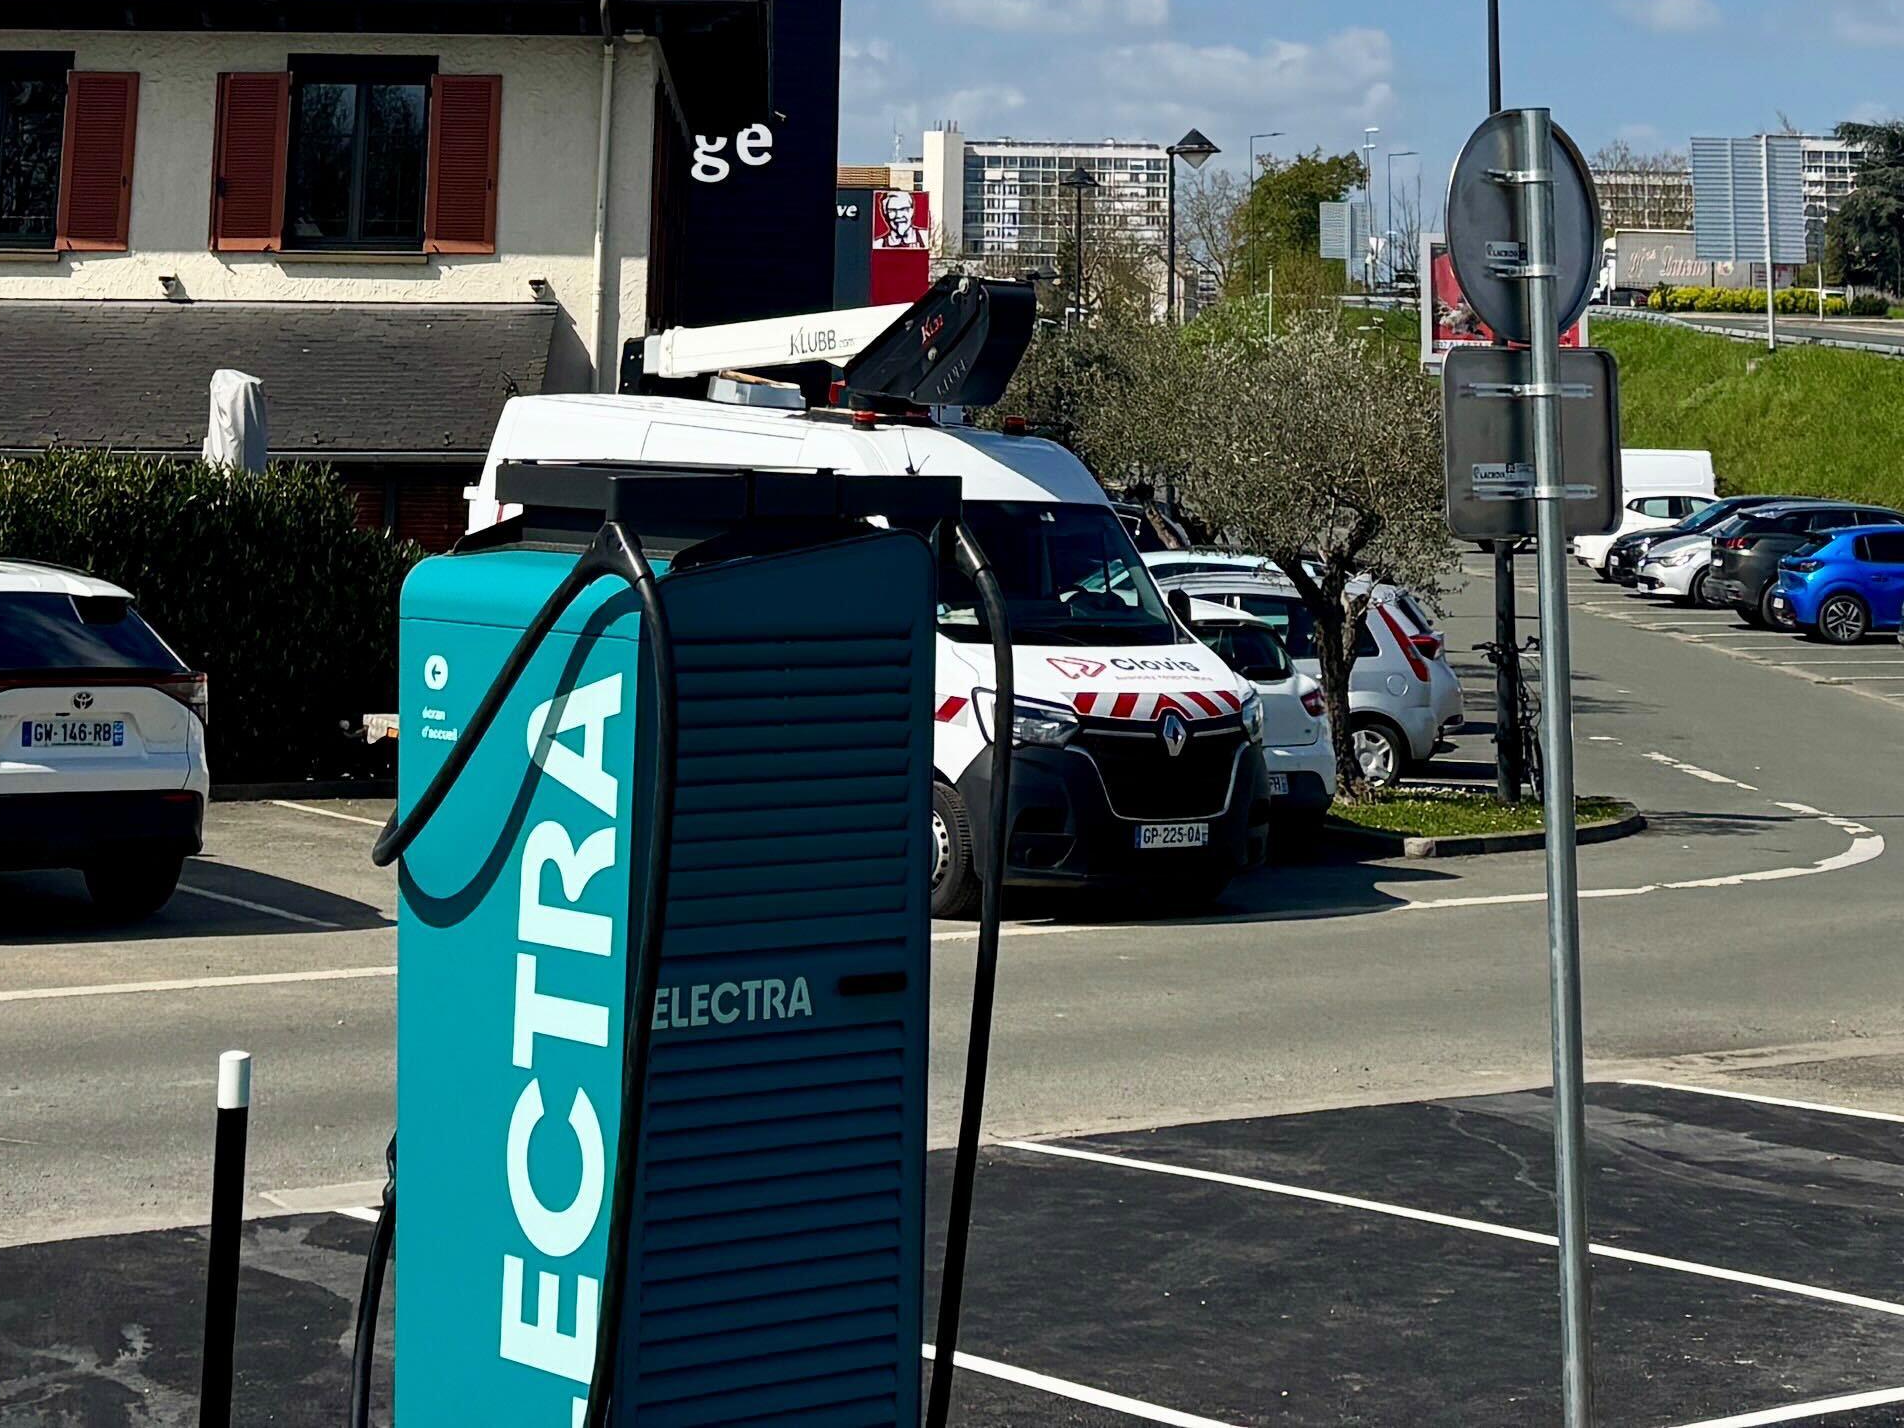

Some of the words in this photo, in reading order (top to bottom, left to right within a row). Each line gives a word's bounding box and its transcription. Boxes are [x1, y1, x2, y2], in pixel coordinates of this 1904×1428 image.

[1110, 657, 1201, 672] Clovis
[33, 722, 112, 742] GW-146-RB
[650, 976, 814, 1031] ELECTRA
[498, 671, 623, 1428] ECTRA
